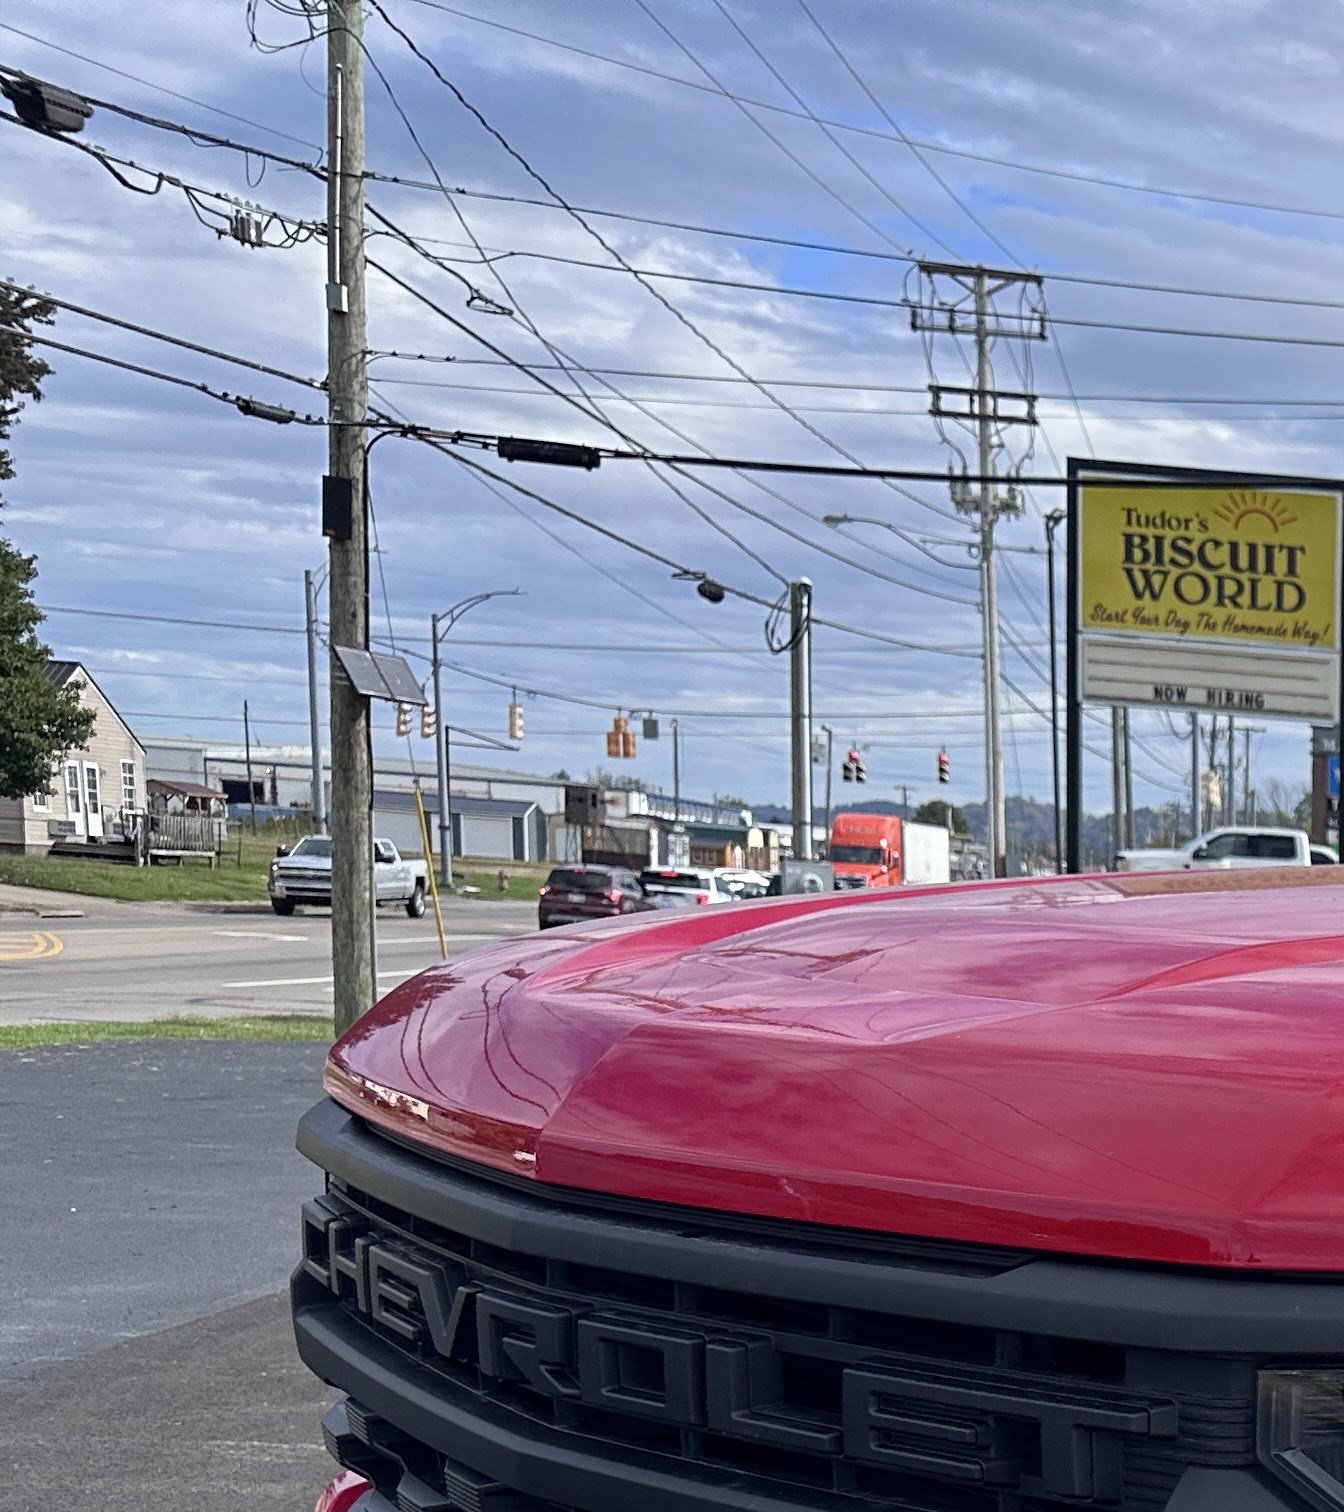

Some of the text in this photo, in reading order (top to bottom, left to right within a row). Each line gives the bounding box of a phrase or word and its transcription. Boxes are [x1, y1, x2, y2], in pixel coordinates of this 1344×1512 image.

[1122, 505, 1210, 533] Tudor's
[1121, 531, 1306, 578] BISCUIT
[1122, 566, 1308, 614] WORLD
[1090, 603, 1129, 625] Start
[1132, 605, 1160, 628] Your
[1164, 608, 1191, 636] Day
[1196, 611, 1217, 632] The
[1221, 613, 1289, 638] Homemade
[1154, 686, 1267, 710] NOW HIRING
[301, 1195, 1180, 1505] CHEVROLET
